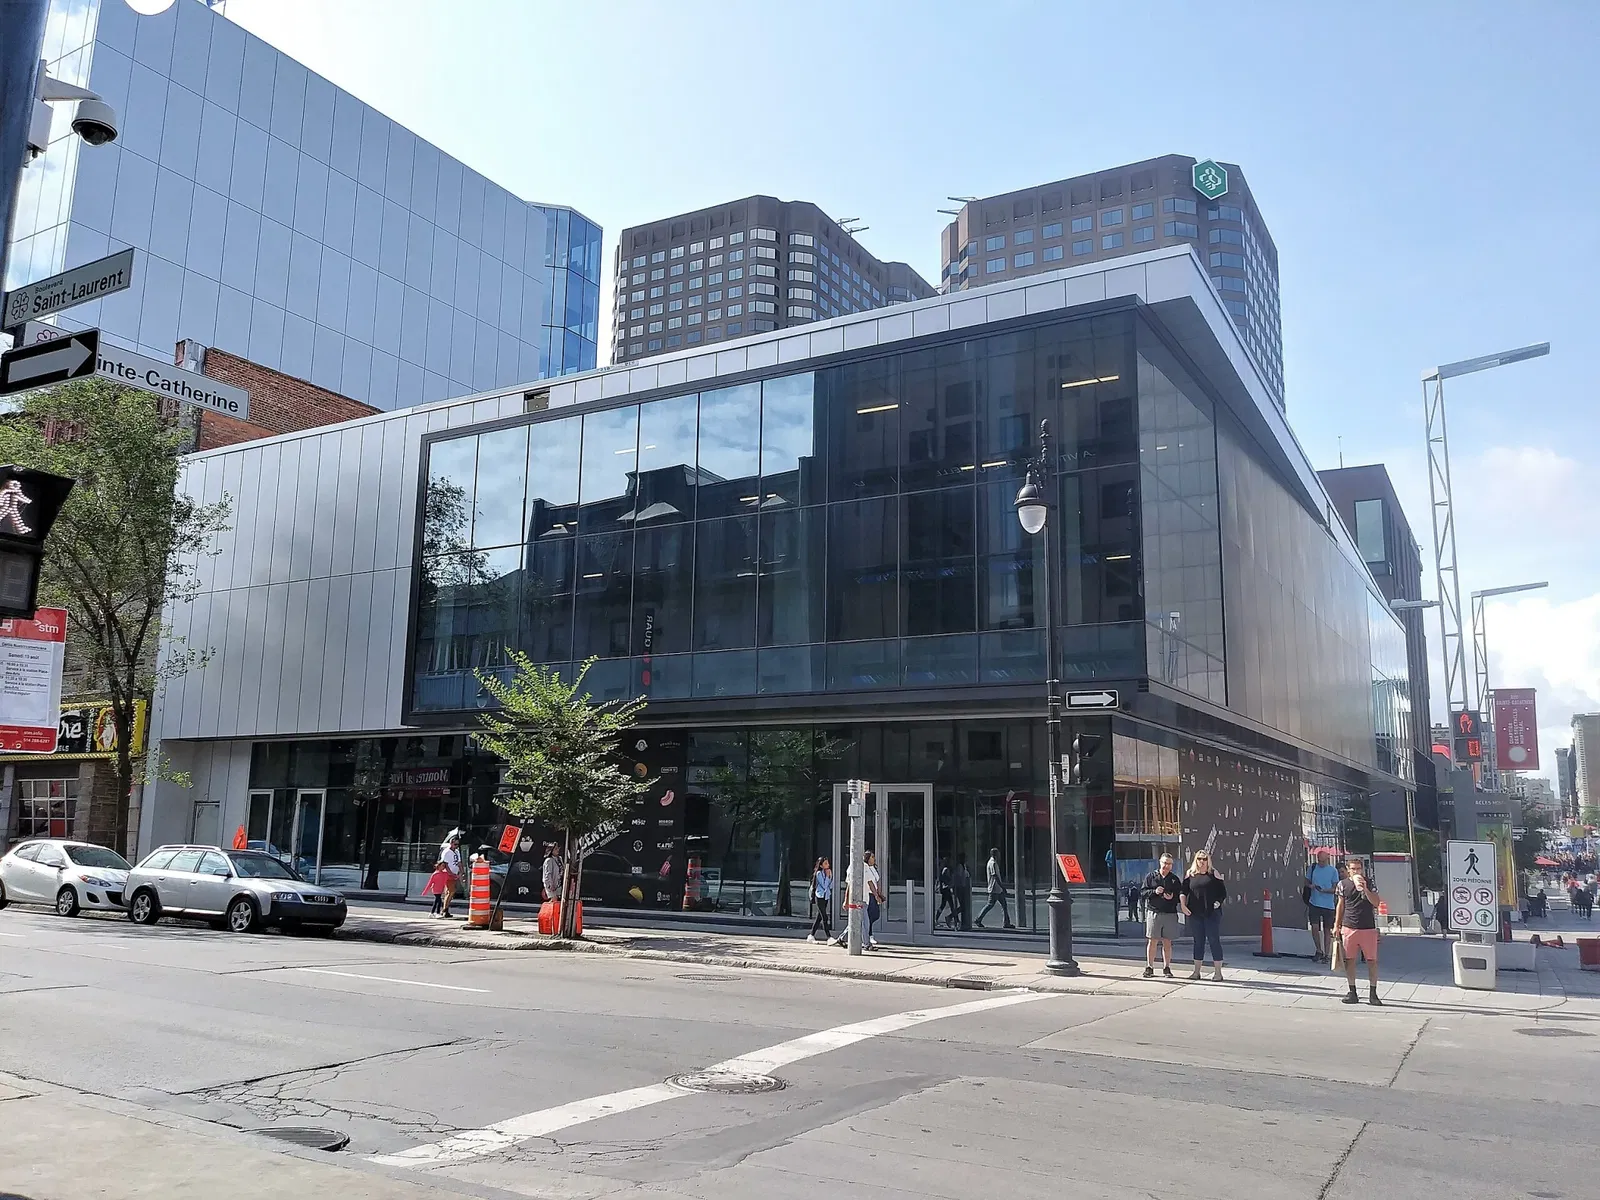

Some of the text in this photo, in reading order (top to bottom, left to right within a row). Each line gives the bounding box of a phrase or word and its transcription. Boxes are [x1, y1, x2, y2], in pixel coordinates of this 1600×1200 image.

[33, 269, 123, 313] Saint-Laurent
[35, 278, 64, 294] Boulevard
[98, 353, 239, 413] inte-Catherine
[38, 624, 59, 633] stm
